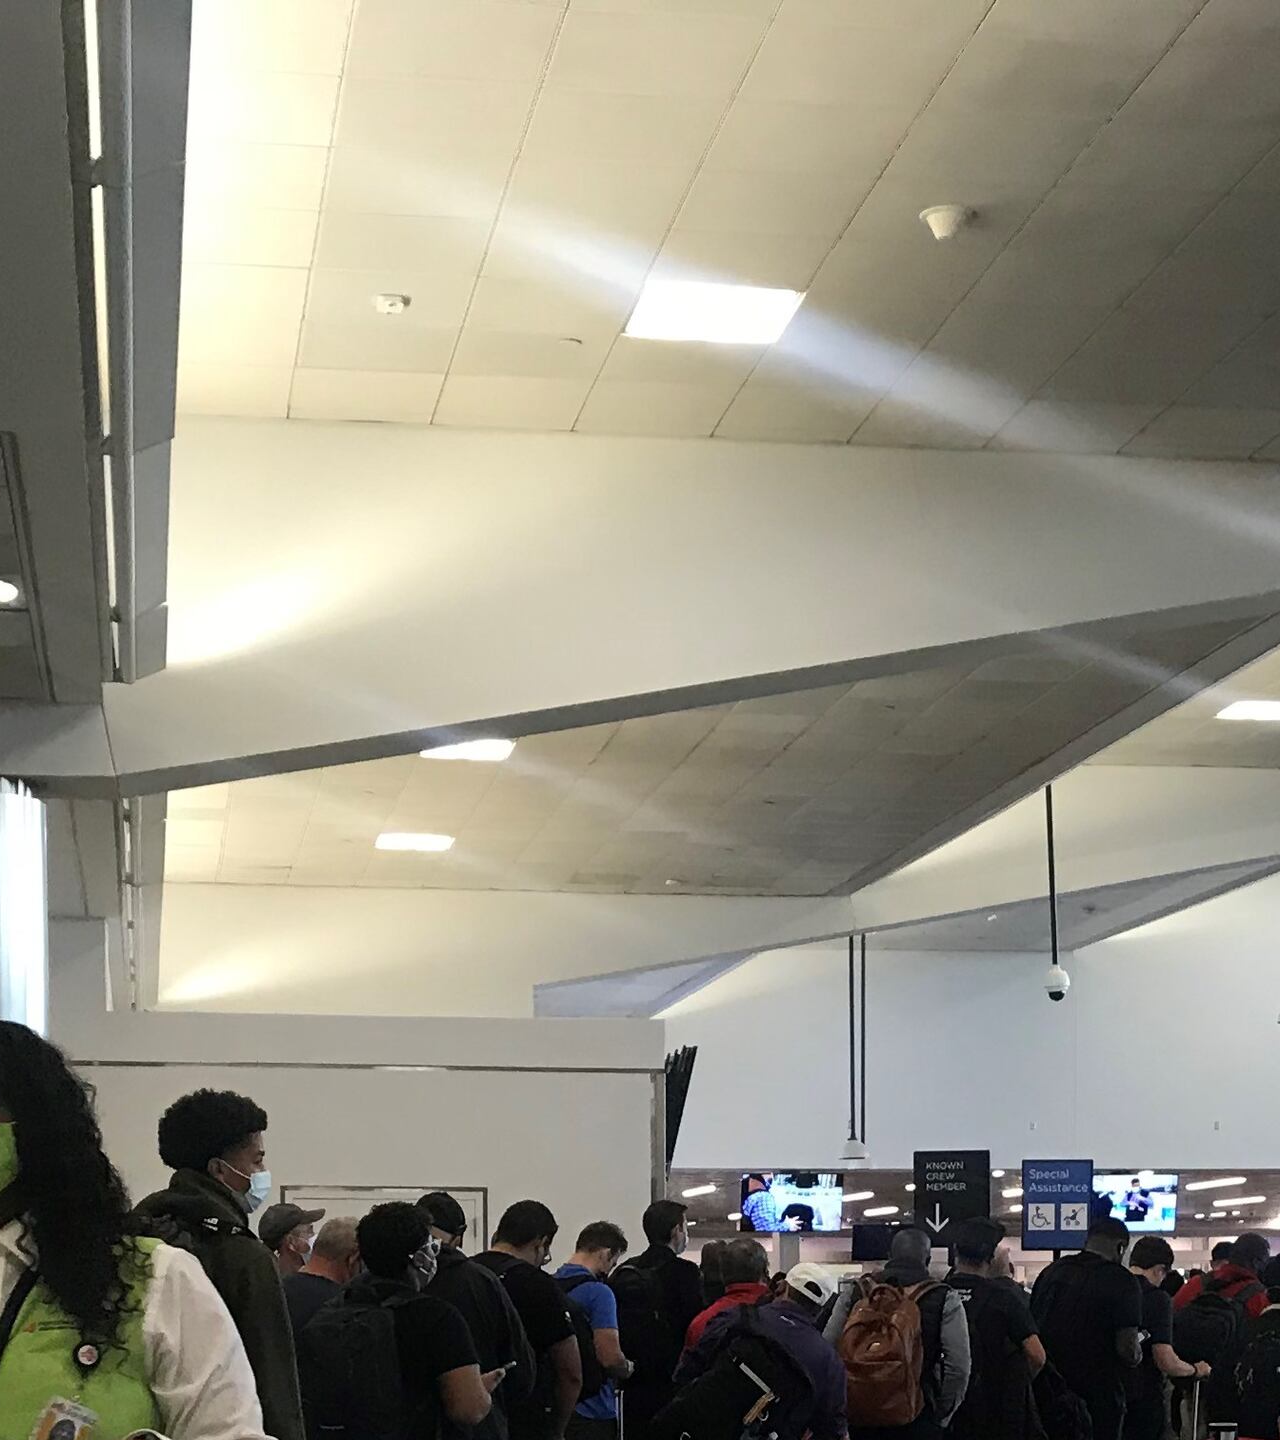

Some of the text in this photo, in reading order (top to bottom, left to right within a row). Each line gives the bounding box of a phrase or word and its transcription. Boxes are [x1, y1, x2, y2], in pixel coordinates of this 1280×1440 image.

[925, 1161, 964, 1170] KNOWN
[925, 1172, 956, 1181] CREW
[1029, 1168, 1070, 1180] Special
[926, 1182, 967, 1191] MEMBER
[1028, 1182, 1089, 1193] Assistance
